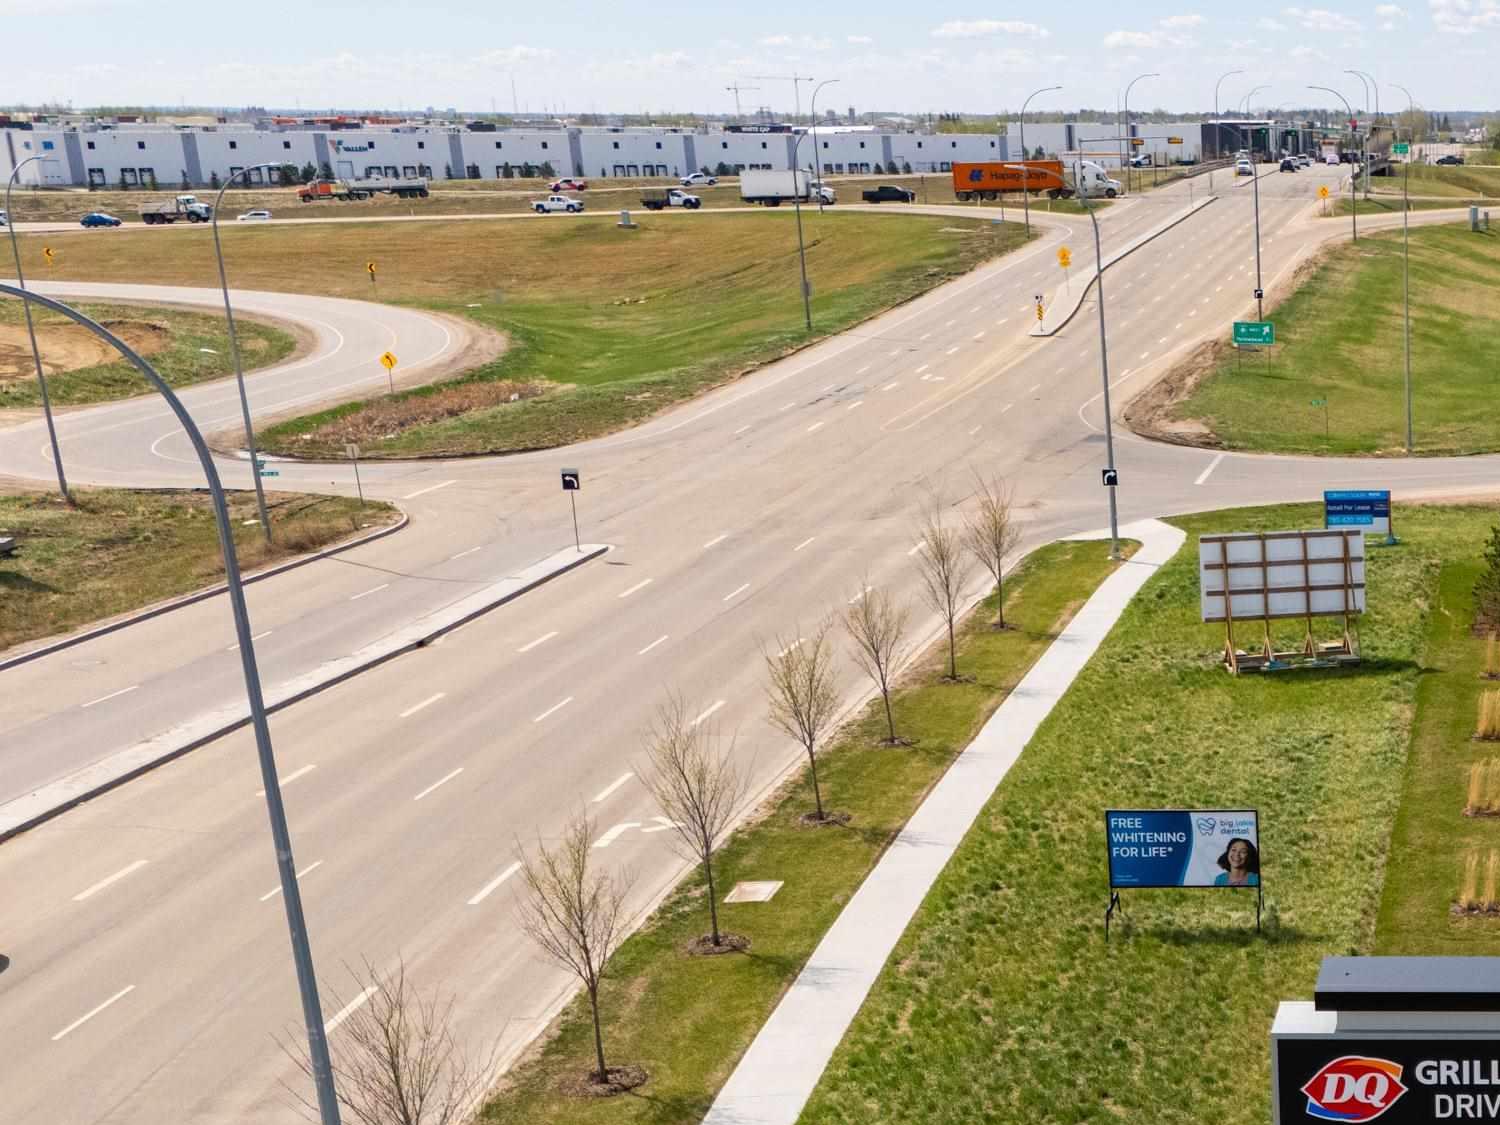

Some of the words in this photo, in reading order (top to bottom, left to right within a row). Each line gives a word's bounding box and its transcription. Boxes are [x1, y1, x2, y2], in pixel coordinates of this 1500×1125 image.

[1111, 818, 1142, 828] FREE
[1112, 832, 1186, 843] WHITENING
[1113, 847, 1138, 857] FOR
[1322, 1073, 1390, 1107] DQ
